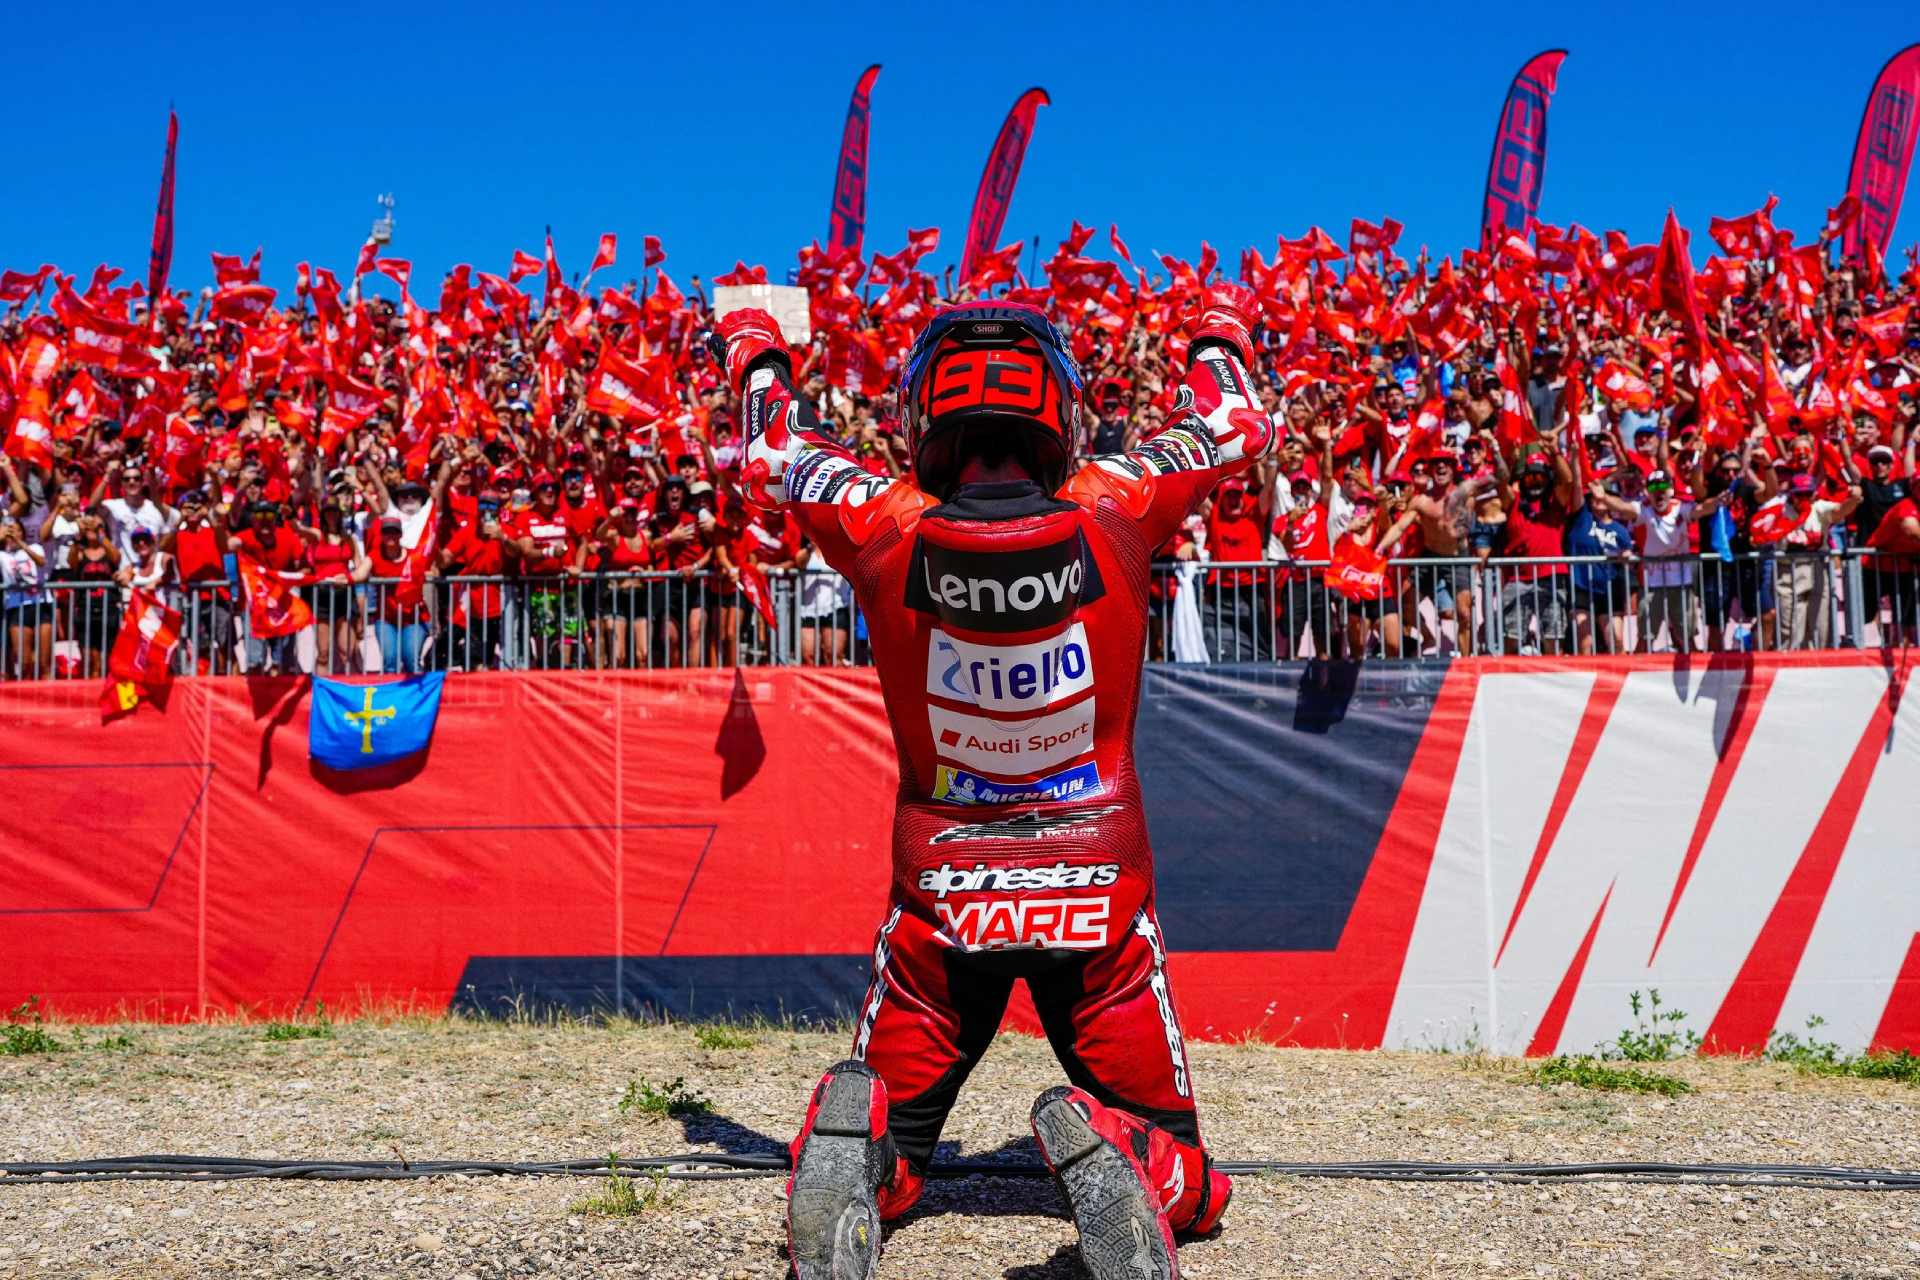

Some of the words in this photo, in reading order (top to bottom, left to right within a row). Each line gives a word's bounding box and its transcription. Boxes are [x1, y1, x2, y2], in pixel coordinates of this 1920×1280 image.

[976, 325, 1001, 333] SHOEI
[931, 350, 1044, 417] 93
[1214, 360, 1237, 392] Lenovo
[752, 390, 764, 436] Lenovo
[808, 464, 836, 498] riello
[923, 555, 1083, 613] Lenovo
[969, 642, 1086, 701] riello
[965, 735, 1020, 754] Audi
[1028, 722, 1089, 752] Sport
[979, 776, 1085, 803] MICHELIN
[918, 862, 1120, 898] alpinestars
[933, 896, 1111, 953] MARC
